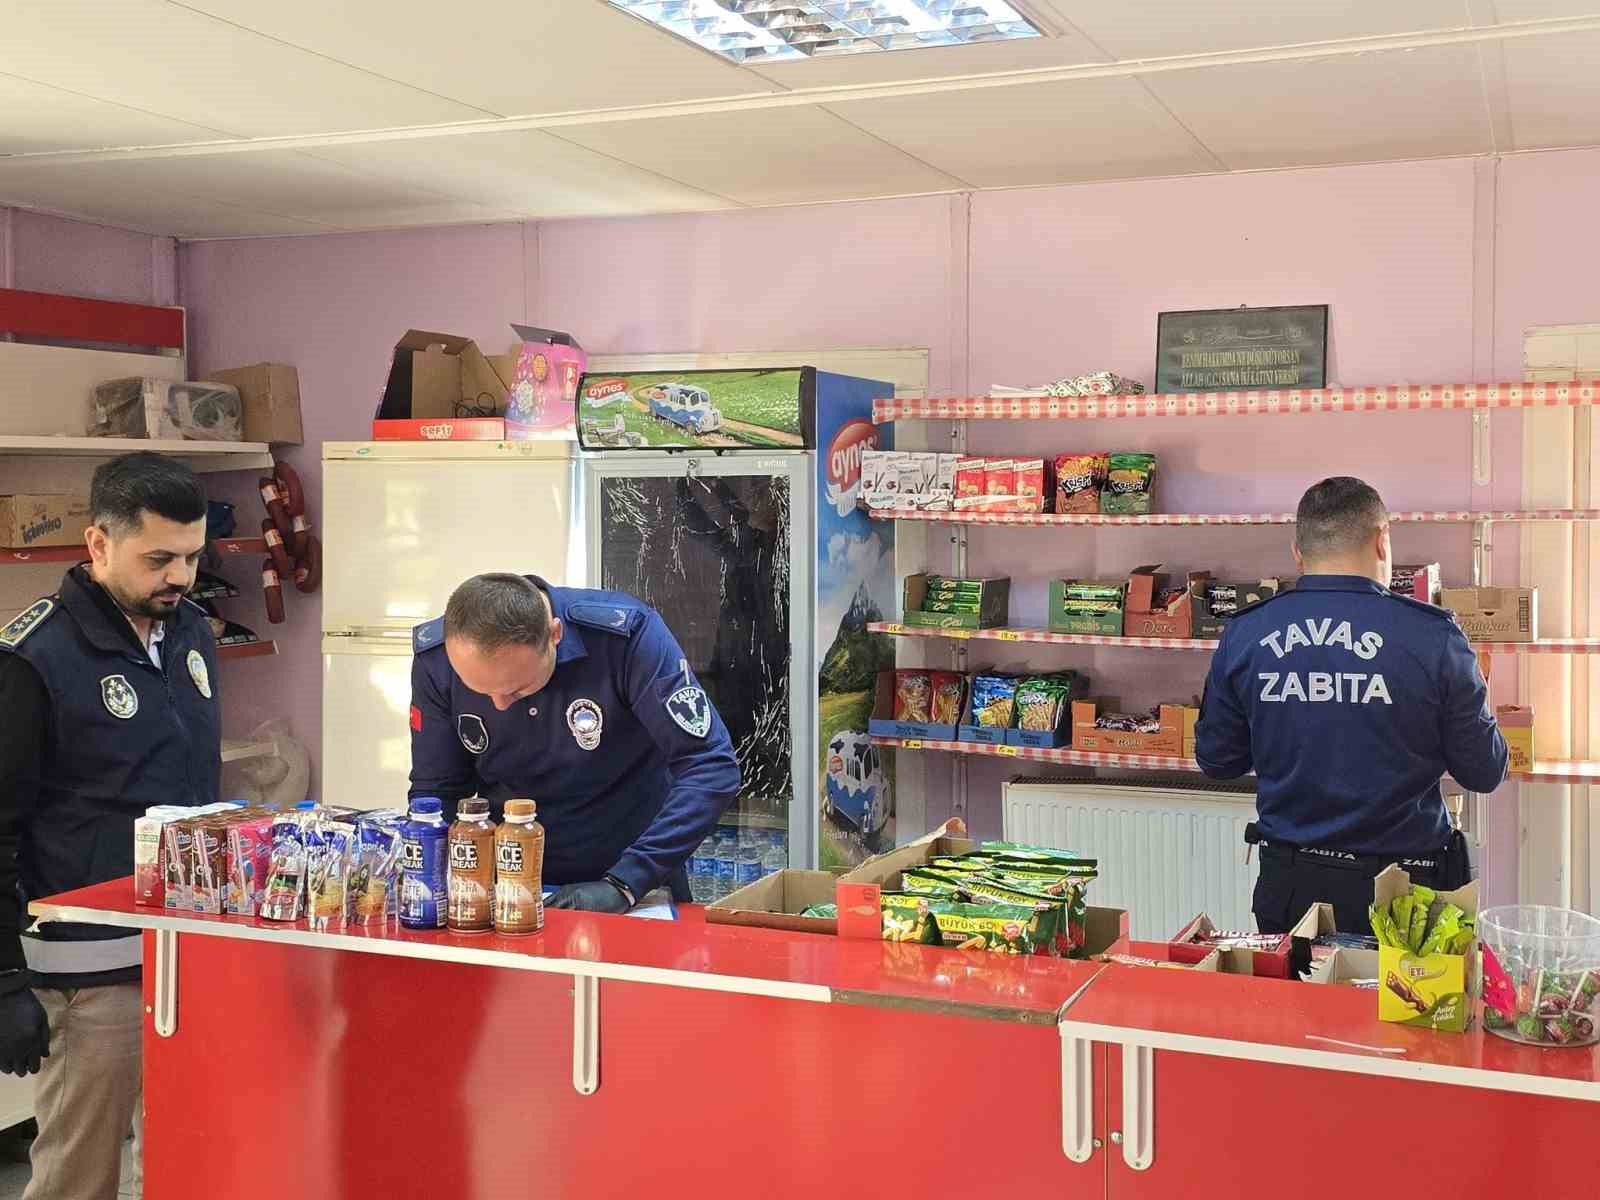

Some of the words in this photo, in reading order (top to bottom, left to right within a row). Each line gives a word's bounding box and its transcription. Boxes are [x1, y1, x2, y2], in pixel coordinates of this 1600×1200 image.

[1259, 617, 1384, 660] TAVAS
[1258, 672, 1393, 705] ZABITA
[402, 843, 424, 861] CE
[450, 843, 478, 861] ICE
[498, 846, 523, 863] ICE
[1300, 847, 1356, 860] ZABITA
[1402, 858, 1436, 868] ZABI
[939, 917, 976, 930] BÜYÜK
